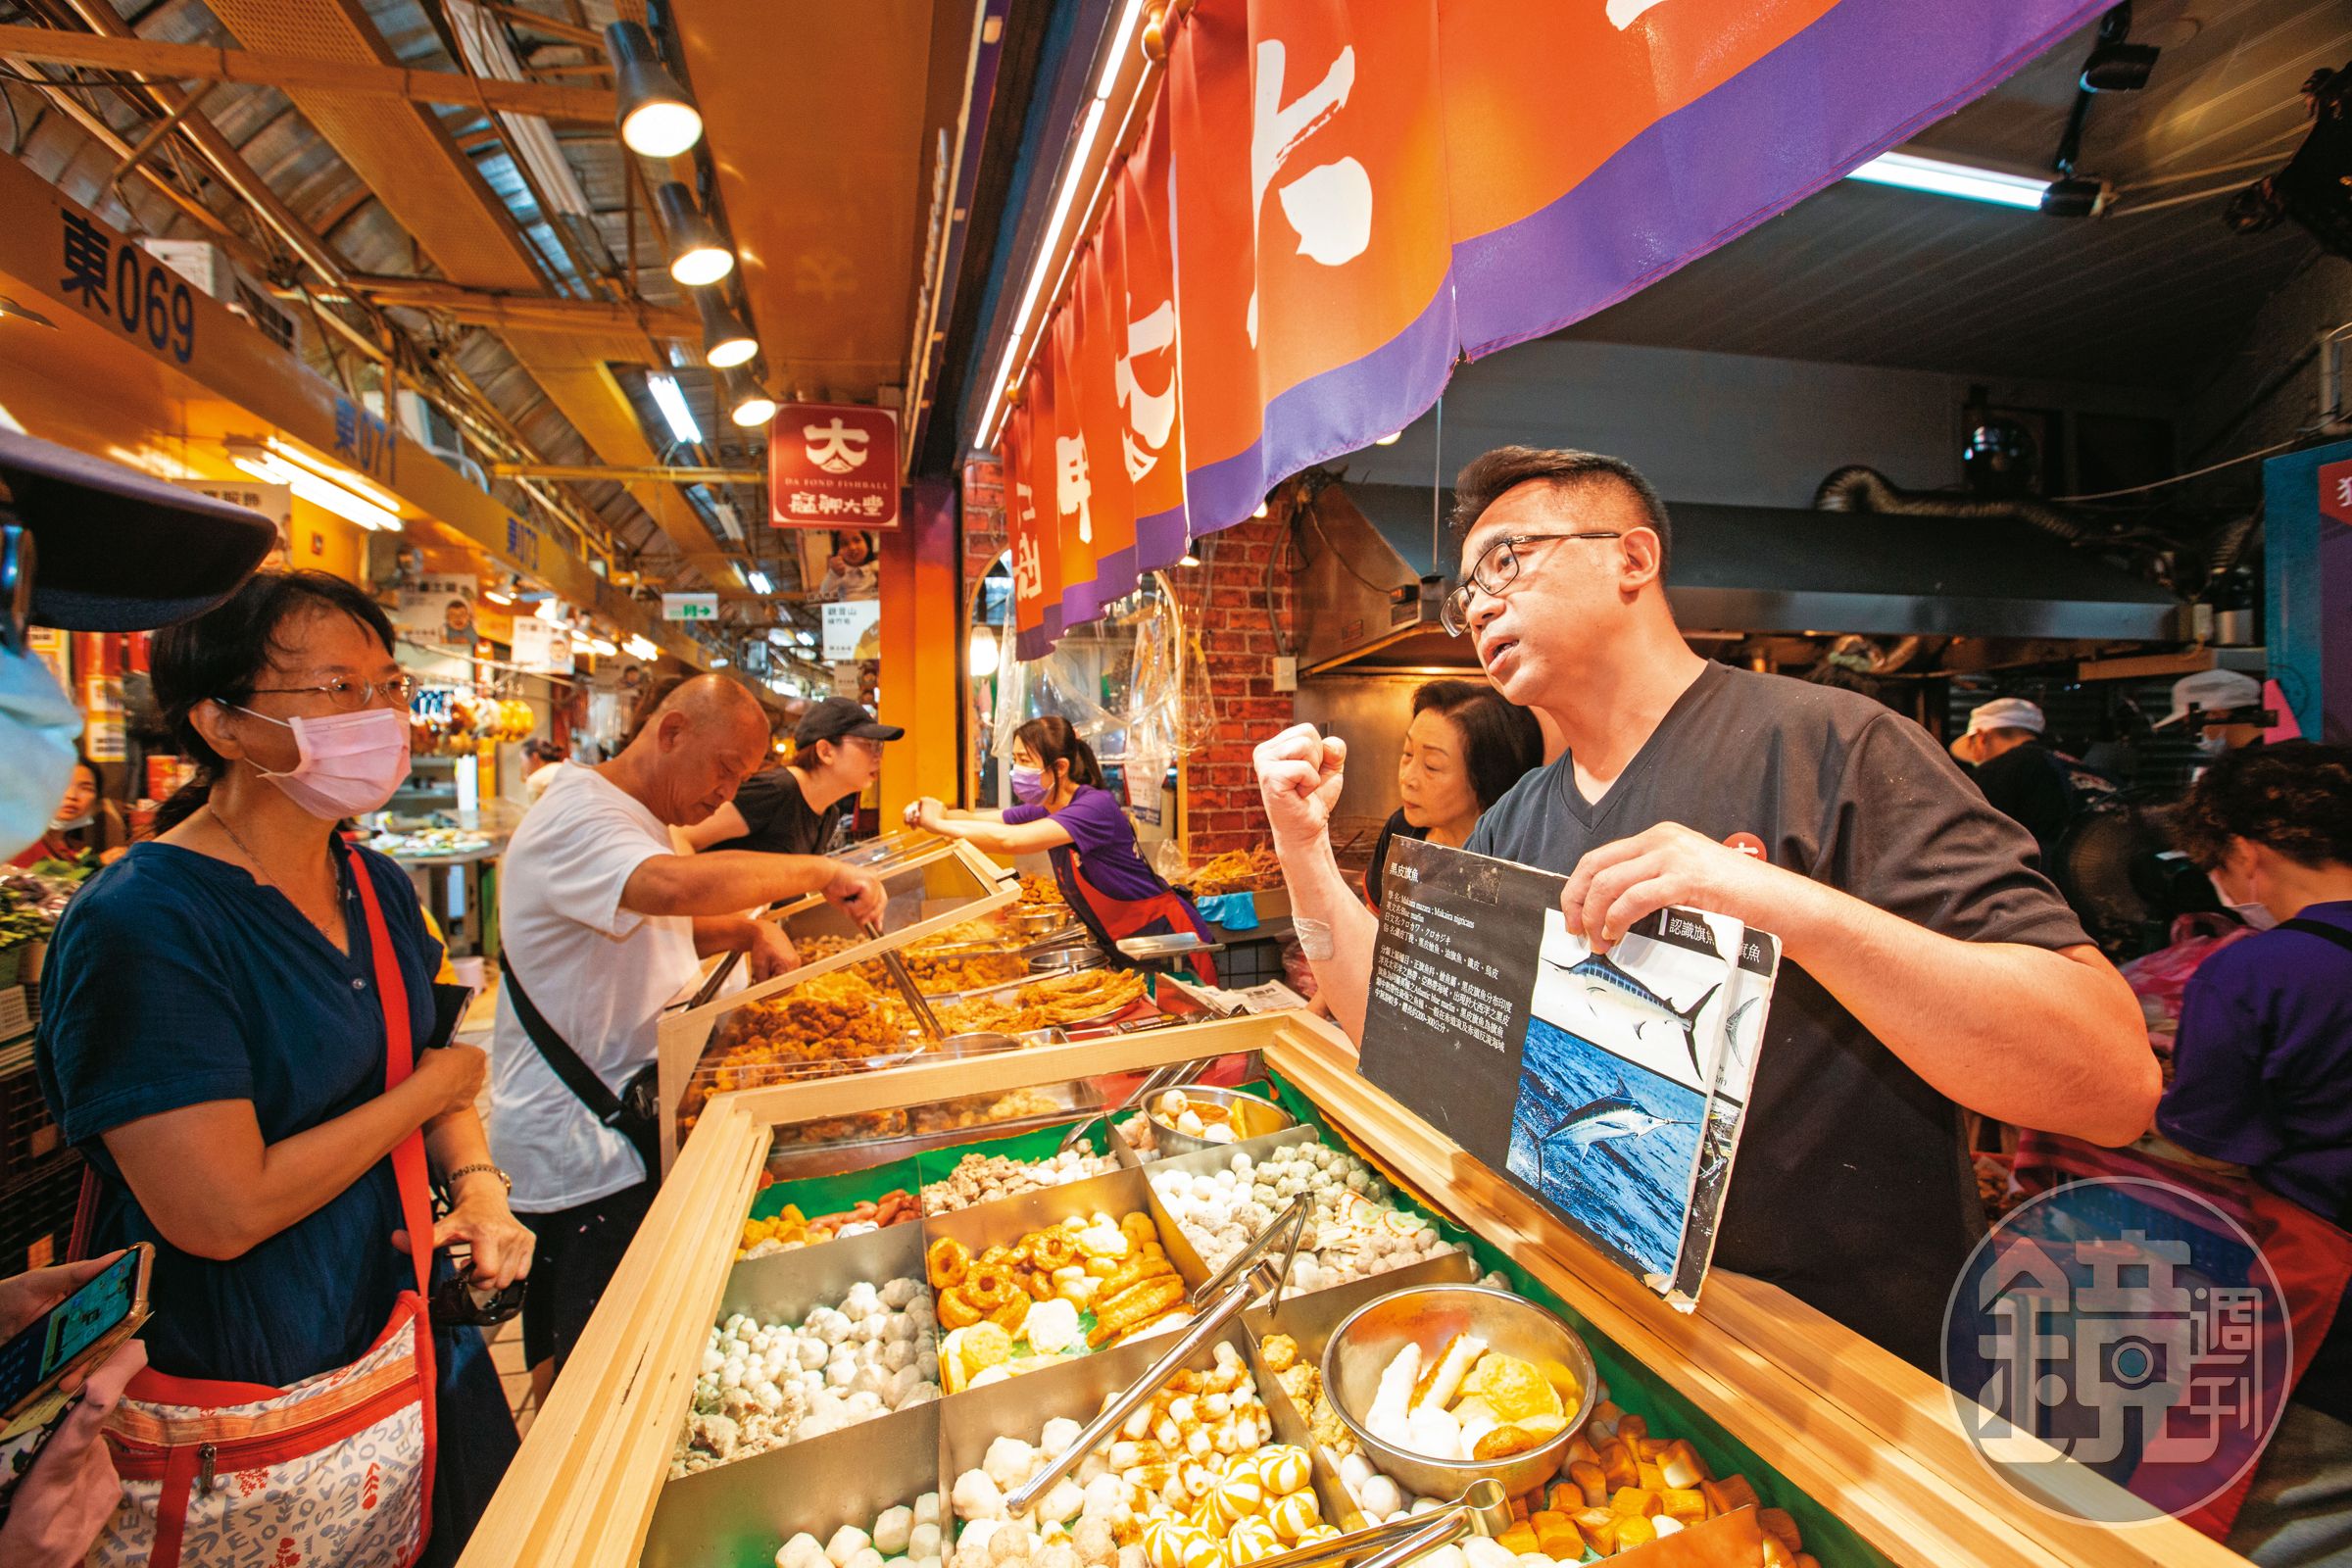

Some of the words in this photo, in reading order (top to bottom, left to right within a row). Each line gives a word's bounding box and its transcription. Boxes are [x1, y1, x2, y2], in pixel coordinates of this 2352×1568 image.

[61, 208, 193, 364] 東069
[1390, 862, 1419, 883] 黑皮旗魚
